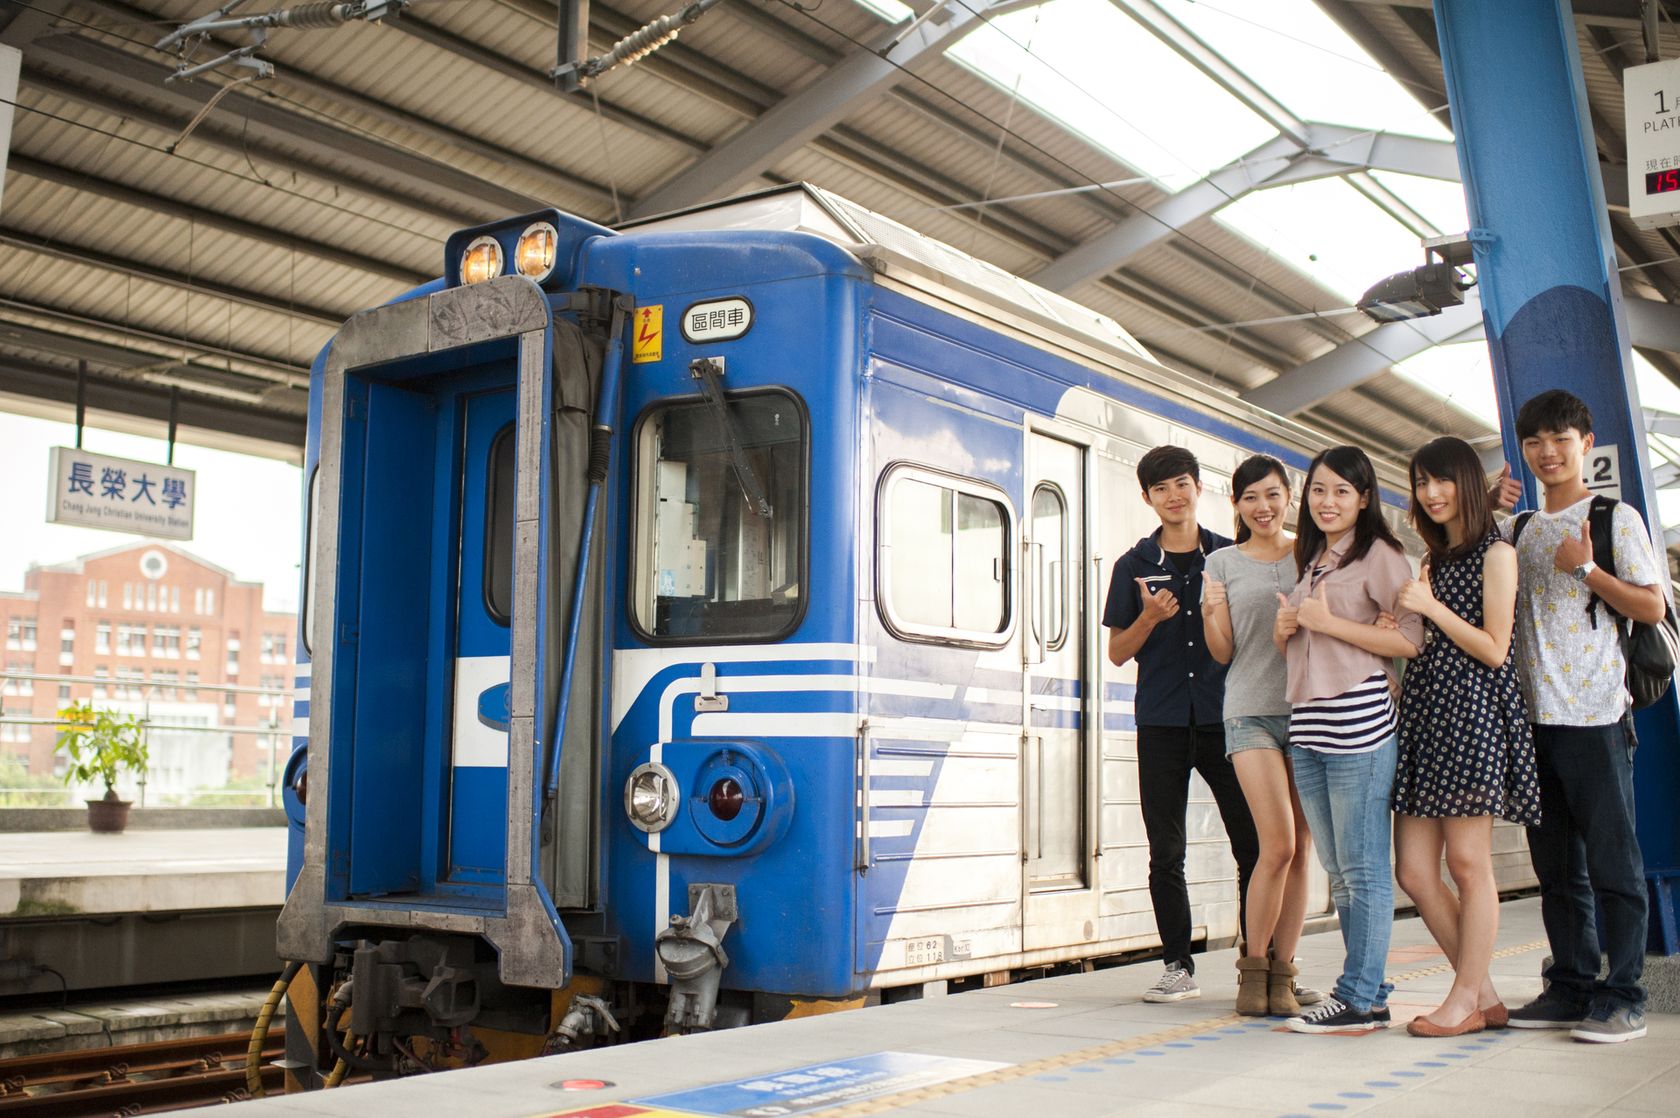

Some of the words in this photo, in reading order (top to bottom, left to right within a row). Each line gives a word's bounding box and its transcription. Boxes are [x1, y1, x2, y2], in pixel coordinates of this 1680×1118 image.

[1654, 90, 1670, 114] 1
[691, 307, 744, 332] 區間車
[68, 462, 186, 509] 長榮大學
